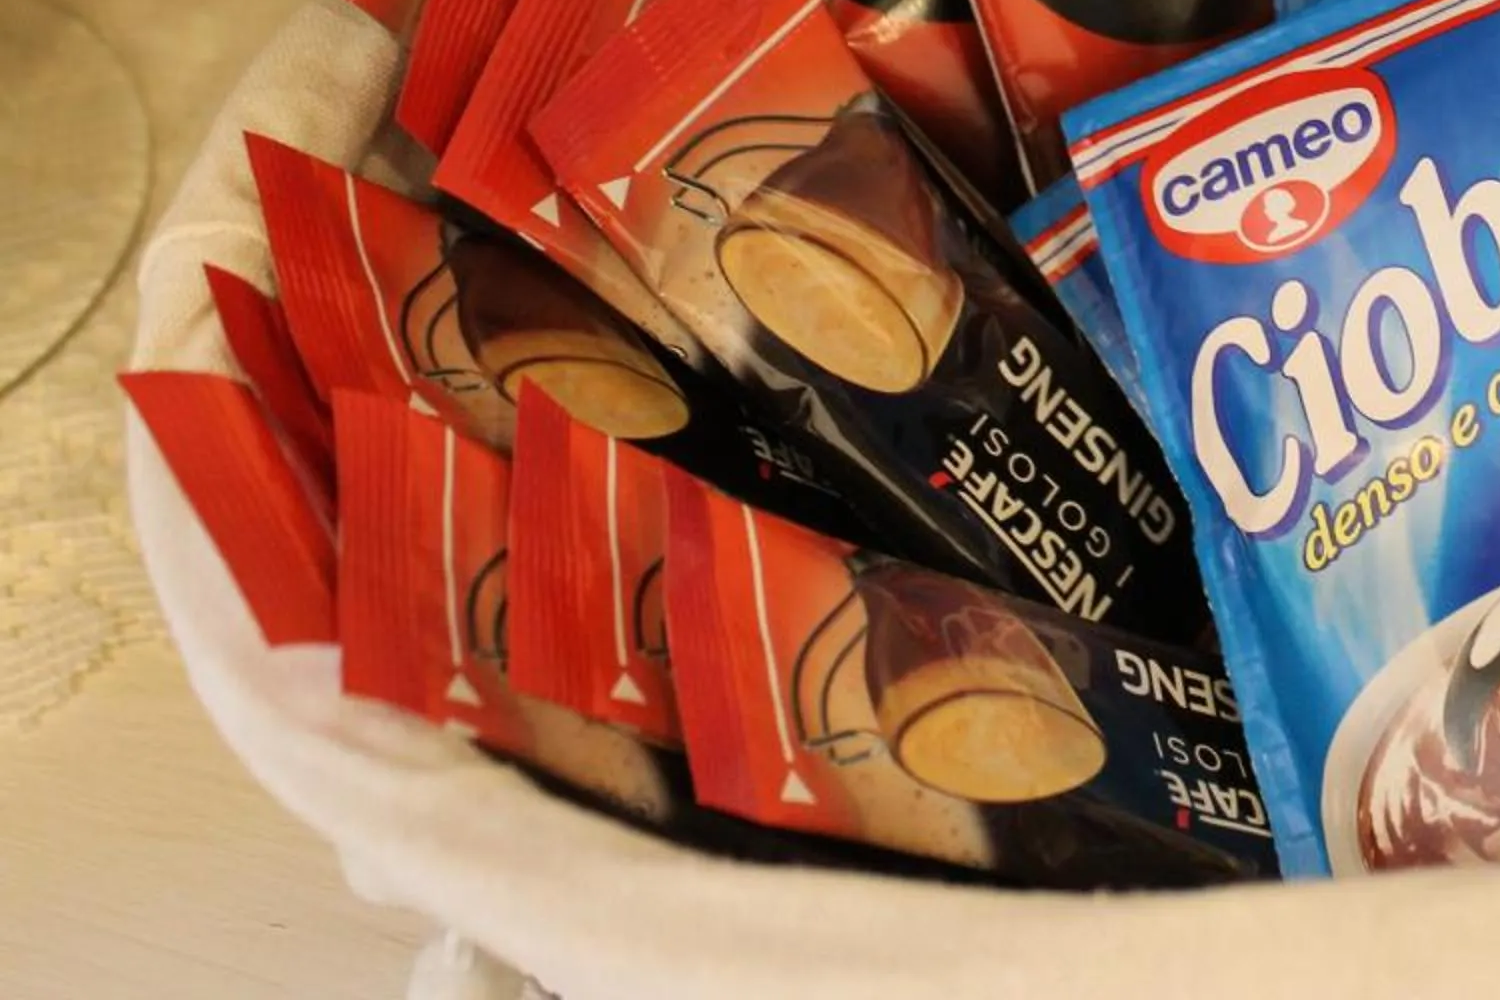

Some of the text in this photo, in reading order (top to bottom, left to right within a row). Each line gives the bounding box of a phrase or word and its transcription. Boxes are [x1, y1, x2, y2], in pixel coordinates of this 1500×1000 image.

[1161, 99, 1374, 217] cameo
[969, 413, 1112, 558] GOLOSI
[997, 336, 1176, 544] GINSENG
[1303, 437, 1444, 573] denso
[1451, 403, 1480, 448] e
